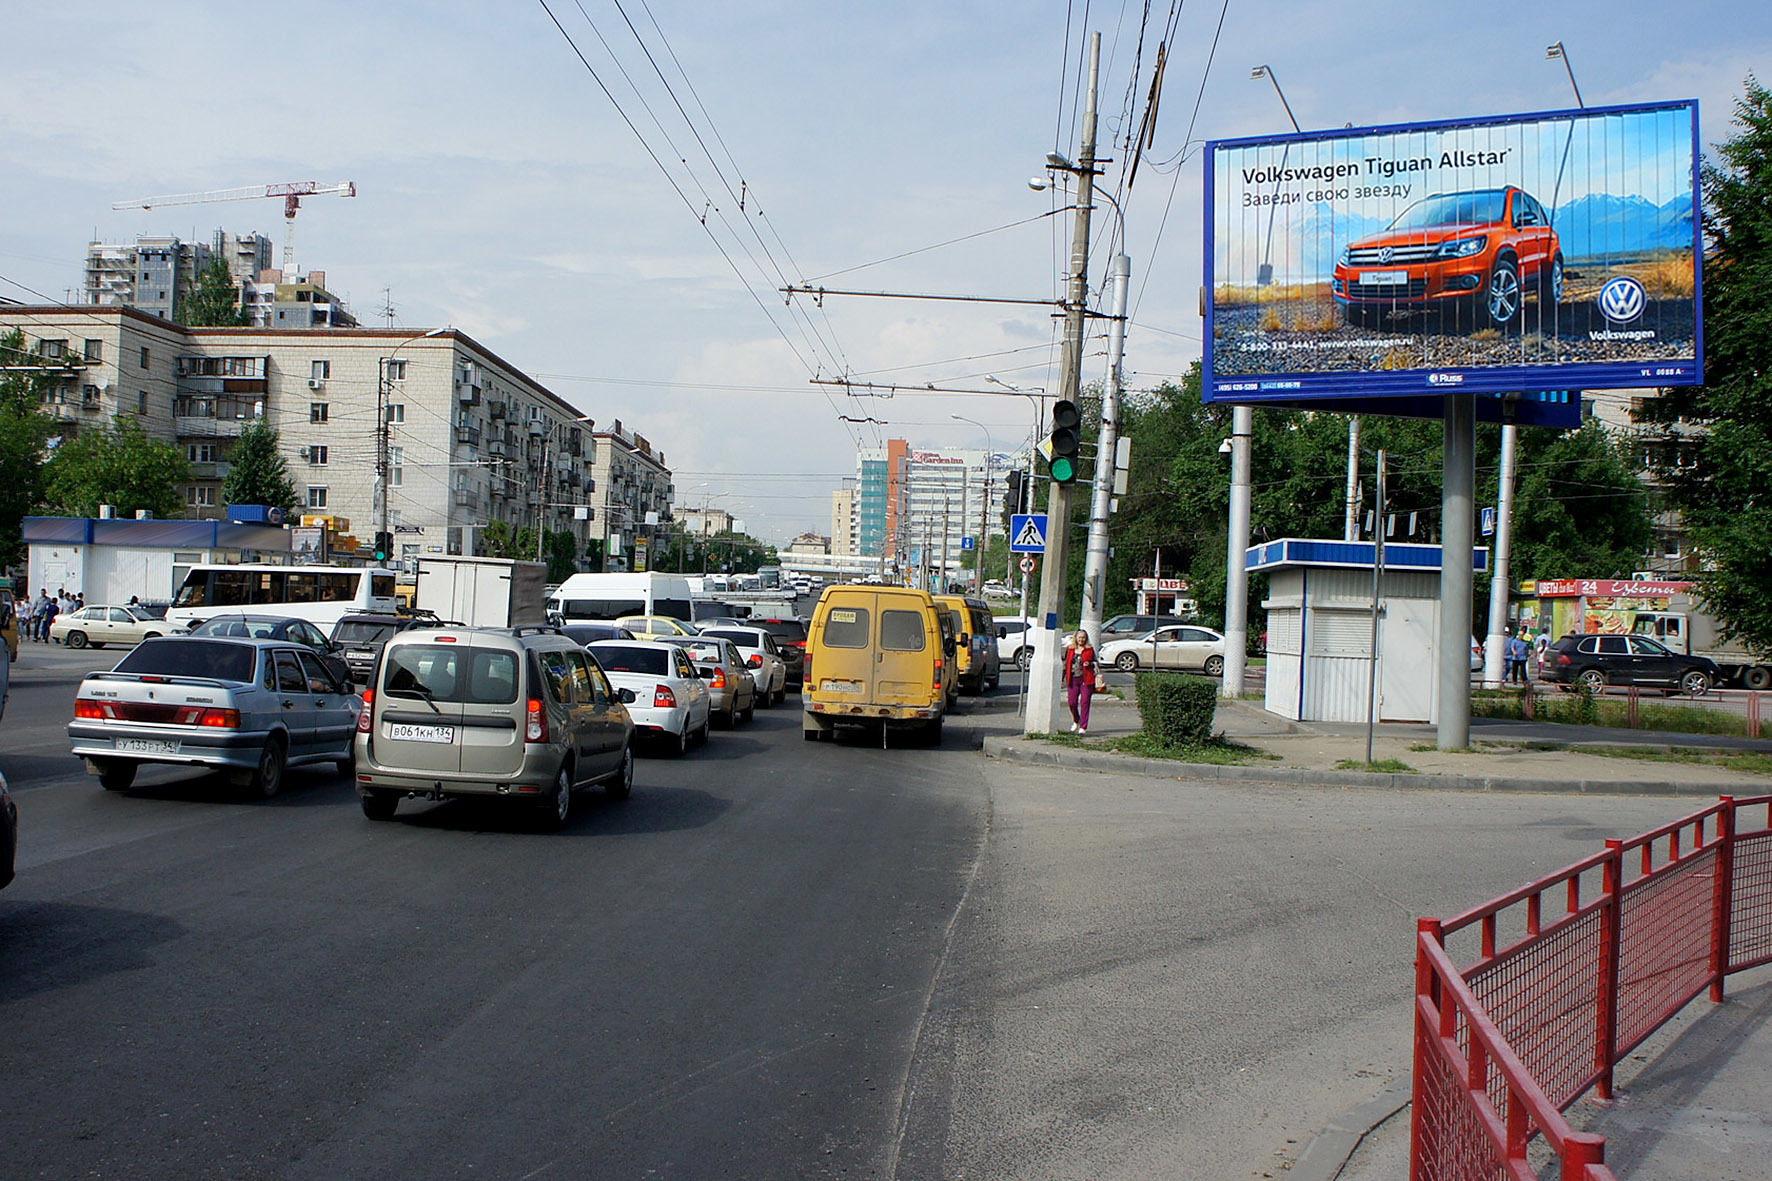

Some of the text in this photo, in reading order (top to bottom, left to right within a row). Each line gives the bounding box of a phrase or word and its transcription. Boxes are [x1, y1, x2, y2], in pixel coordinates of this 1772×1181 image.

[1242, 163, 1359, 184] Volkswagen
[1364, 157, 1432, 178] Tiguan
[1242, 184, 1412, 207] Заведи свою звезду
[1589, 329, 1656, 341] Volkswagen
[1440, 374, 1463, 383] Russ
[923, 456, 950, 464] Garden
[1538, 582, 1559, 597] ЦВЕТЫ
[1582, 581, 1597, 591] 24
[1611, 581, 1676, 596] Цветы
